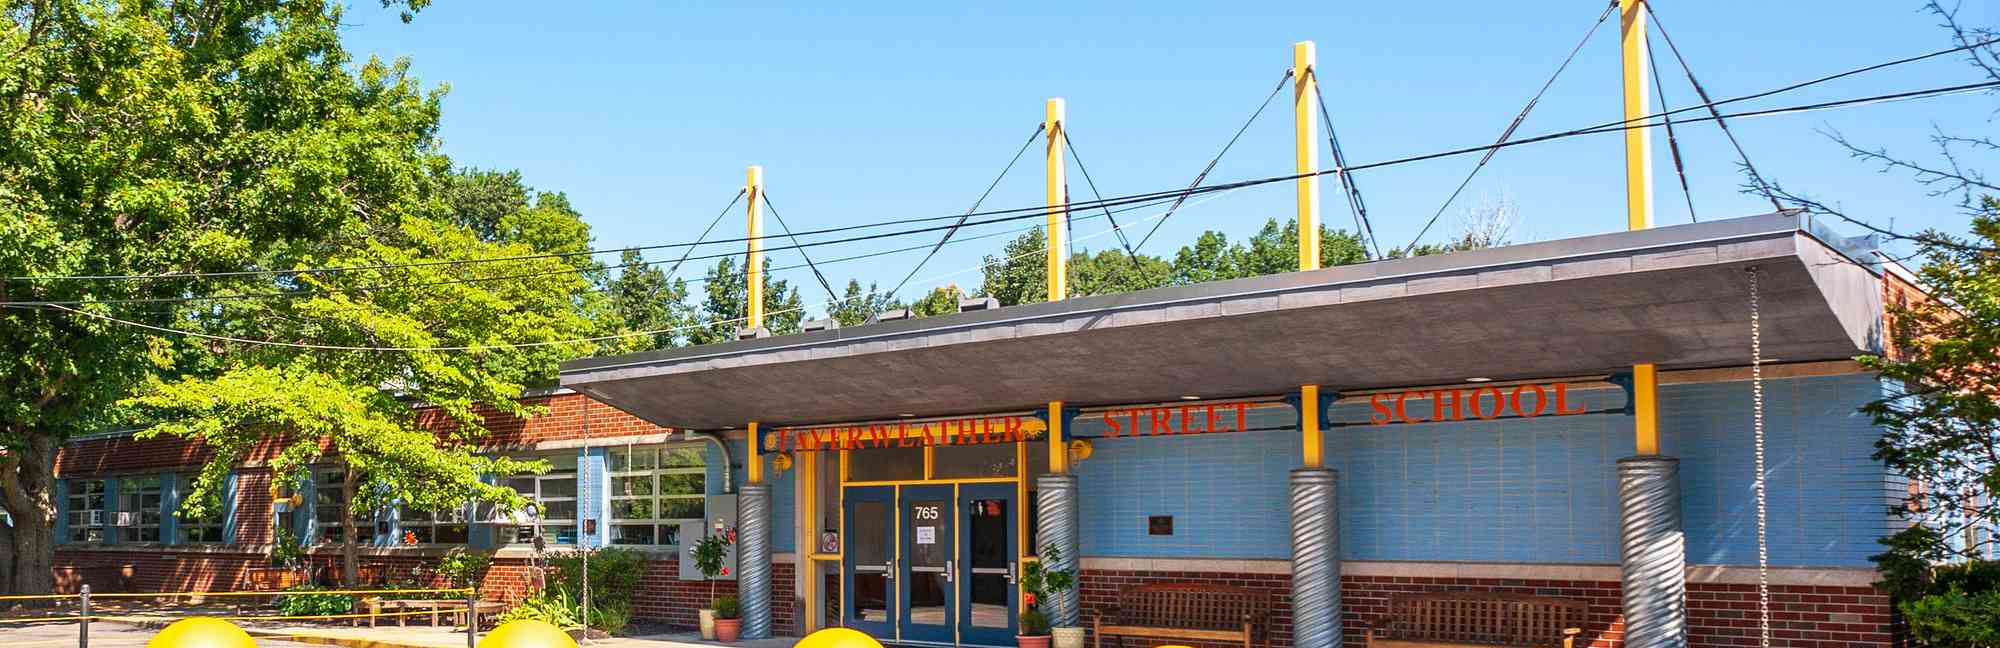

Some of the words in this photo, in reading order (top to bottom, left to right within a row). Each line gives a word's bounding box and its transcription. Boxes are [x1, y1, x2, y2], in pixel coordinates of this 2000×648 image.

[1103, 402, 1256, 437] STREET
[1369, 382, 1585, 425] SCHOOL
[915, 506, 938, 520] 765
